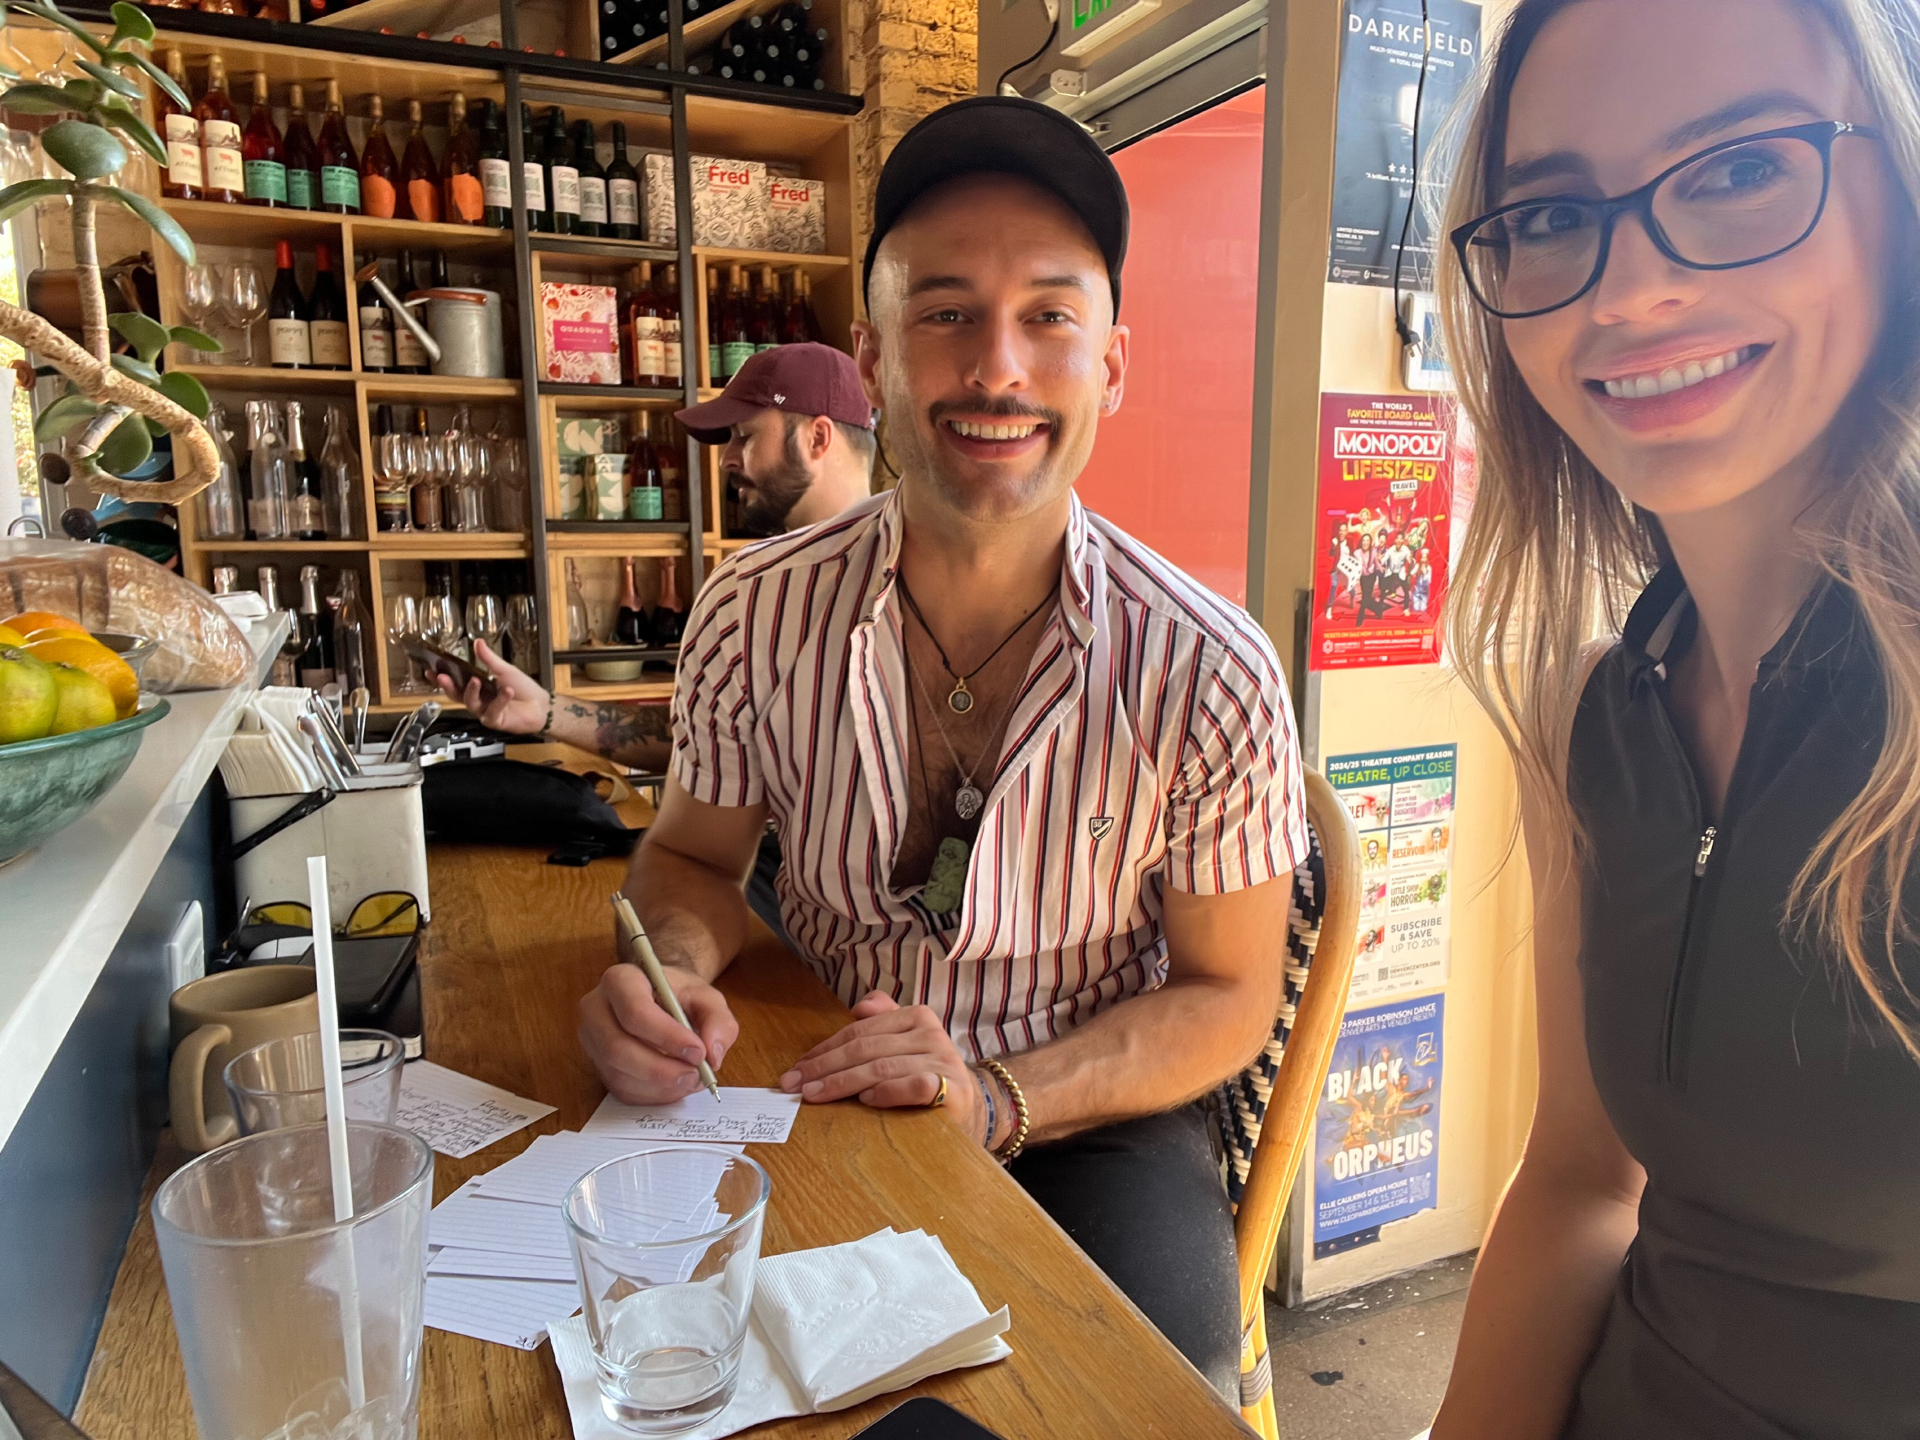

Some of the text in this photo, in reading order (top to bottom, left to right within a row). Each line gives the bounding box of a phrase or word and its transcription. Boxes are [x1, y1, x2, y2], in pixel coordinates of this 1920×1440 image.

[1349, 14, 1473, 55] DARKFELD
[708, 165, 750, 185] Fred
[770, 184, 809, 202] Fred
[1347, 408, 1383, 419] FAVORITE
[1384, 410, 1412, 420] BOARD
[1371, 402, 1413, 411] THE WORLD'S
[1338, 432, 1443, 456] MONOPOLY
[1342, 459, 1438, 482] LIFESIZED
[1392, 482, 1416, 490] TRAVEL
[1330, 750, 1453, 771] 2024/25 THEATRE COMPANY SEASON
[1330, 760, 1453, 785] THEATRE, UP CLOSE
[1349, 804, 1365, 818] LET
[1392, 845, 1425, 859] RESERVOIR
[1391, 884, 1419, 896] LITTLE SHOP
[1391, 892, 1422, 907] HORRORS
[1391, 917, 1442, 933] SUBSCRIBE
[1400, 928, 1432, 942] & SAVE
[1391, 937, 1440, 953] UP TO 20%
[1390, 961, 1441, 974] DENVERCENTER.ORG
[1348, 1016, 1375, 1028] PARKER
[1376, 1009, 1413, 1023] ROBINSON
[1414, 1002, 1436, 1015] DANCE
[1365, 1023, 1380, 1033] ARTS
[1387, 1016, 1411, 1028] VENUES
[1412, 1010, 1436, 1022] PRESENT
[1327, 1058, 1403, 1102] BLACK
[1333, 1128, 1433, 1181] ORPHEUS
[1319, 1202, 1363, 1220] SEPTEMBER
[1364, 1198, 1372, 1208] 14
[1391, 1187, 1408, 1199] 2024
[1320, 1179, 1408, 1210] ELLIE CAULKINS OPERA HOUSE
